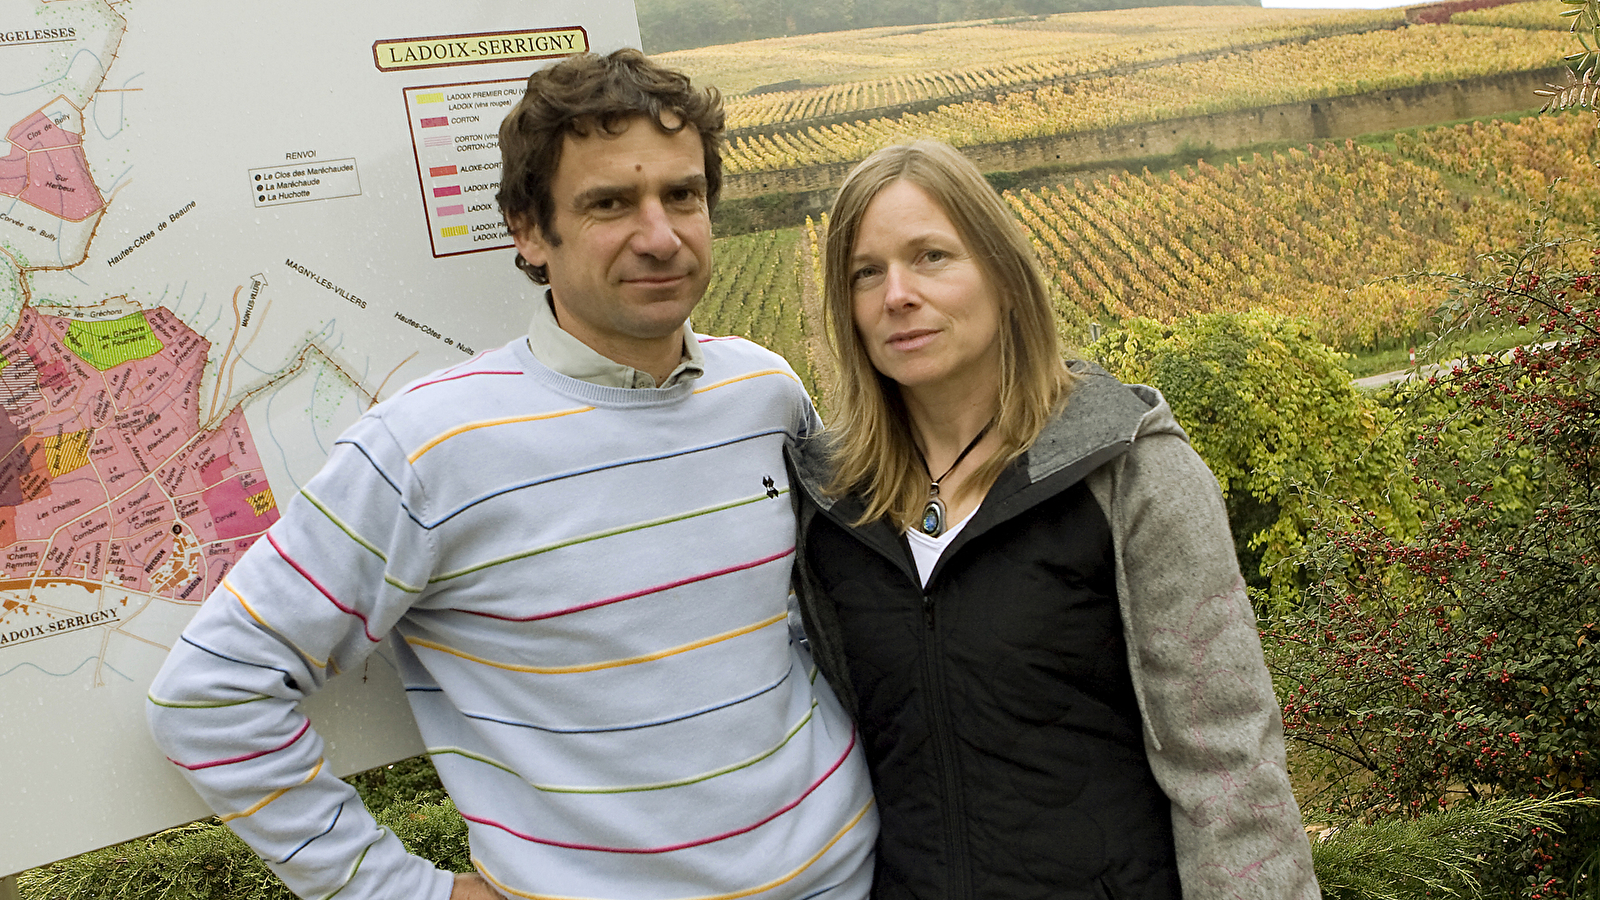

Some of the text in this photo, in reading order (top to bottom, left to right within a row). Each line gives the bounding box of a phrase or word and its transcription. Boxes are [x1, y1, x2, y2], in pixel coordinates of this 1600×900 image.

[389, 34, 576, 63] LADOIX-SERRIGNY
[473, 90, 502, 98] PREMIER
[504, 88, 517, 96] CRU
[475, 101, 488, 109] (vins
[490, 99, 512, 108] rouges)
[451, 116, 480, 124] CORTON
[27, 130, 41, 140] Clos
[44, 124, 52, 132] de
[455, 134, 482, 143] CORTON
[286, 150, 316, 160] RENVOI
[275, 172, 290, 180] Clos
[307, 164, 354, 175] Maréchaudes
[56, 174, 68, 182] Sur
[46, 181, 76, 193] Herbeux
[266, 183, 274, 191] La
[277, 178, 320, 189] Maréchaude
[464, 184, 488, 192] LADOIX
[279, 190, 310, 200] Huchotte
[468, 204, 492, 212] LADOIX
[472, 222, 496, 232] LADOIX
[40, 230, 57, 242] Bully
[107, 200, 196, 267] Hautes-Côtes de Beaune
[474, 232, 498, 242] LADOIX
[285, 259, 367, 309] MAGNY-LES-VILLERS
[14, 314, 30, 340] Bois de
[55, 321, 65, 330] En
[156, 312, 178, 332] Bois de
[394, 312, 475, 356] Hautes-Côtes de Nuits
[170, 336, 190, 357] Le Bois
[147, 367, 158, 377] Sur
[110, 375, 119, 386] Les
[115, 414, 128, 422] Bois
[153, 428, 162, 436] La
[123, 432, 132, 444] Les
[178, 434, 207, 461] La Combe
[191, 446, 211, 470] Le Clou
[109, 466, 117, 474] Le
[158, 469, 166, 478] La
[110, 472, 126, 483] Clou
[163, 467, 176, 487] Toppe
[37, 512, 49, 520] Les
[128, 506, 165, 524] Les Toppes
[80, 520, 92, 528] Les
[130, 543, 142, 552] Les
[46, 547, 59, 560] Clos
[55, 552, 64, 563] des
